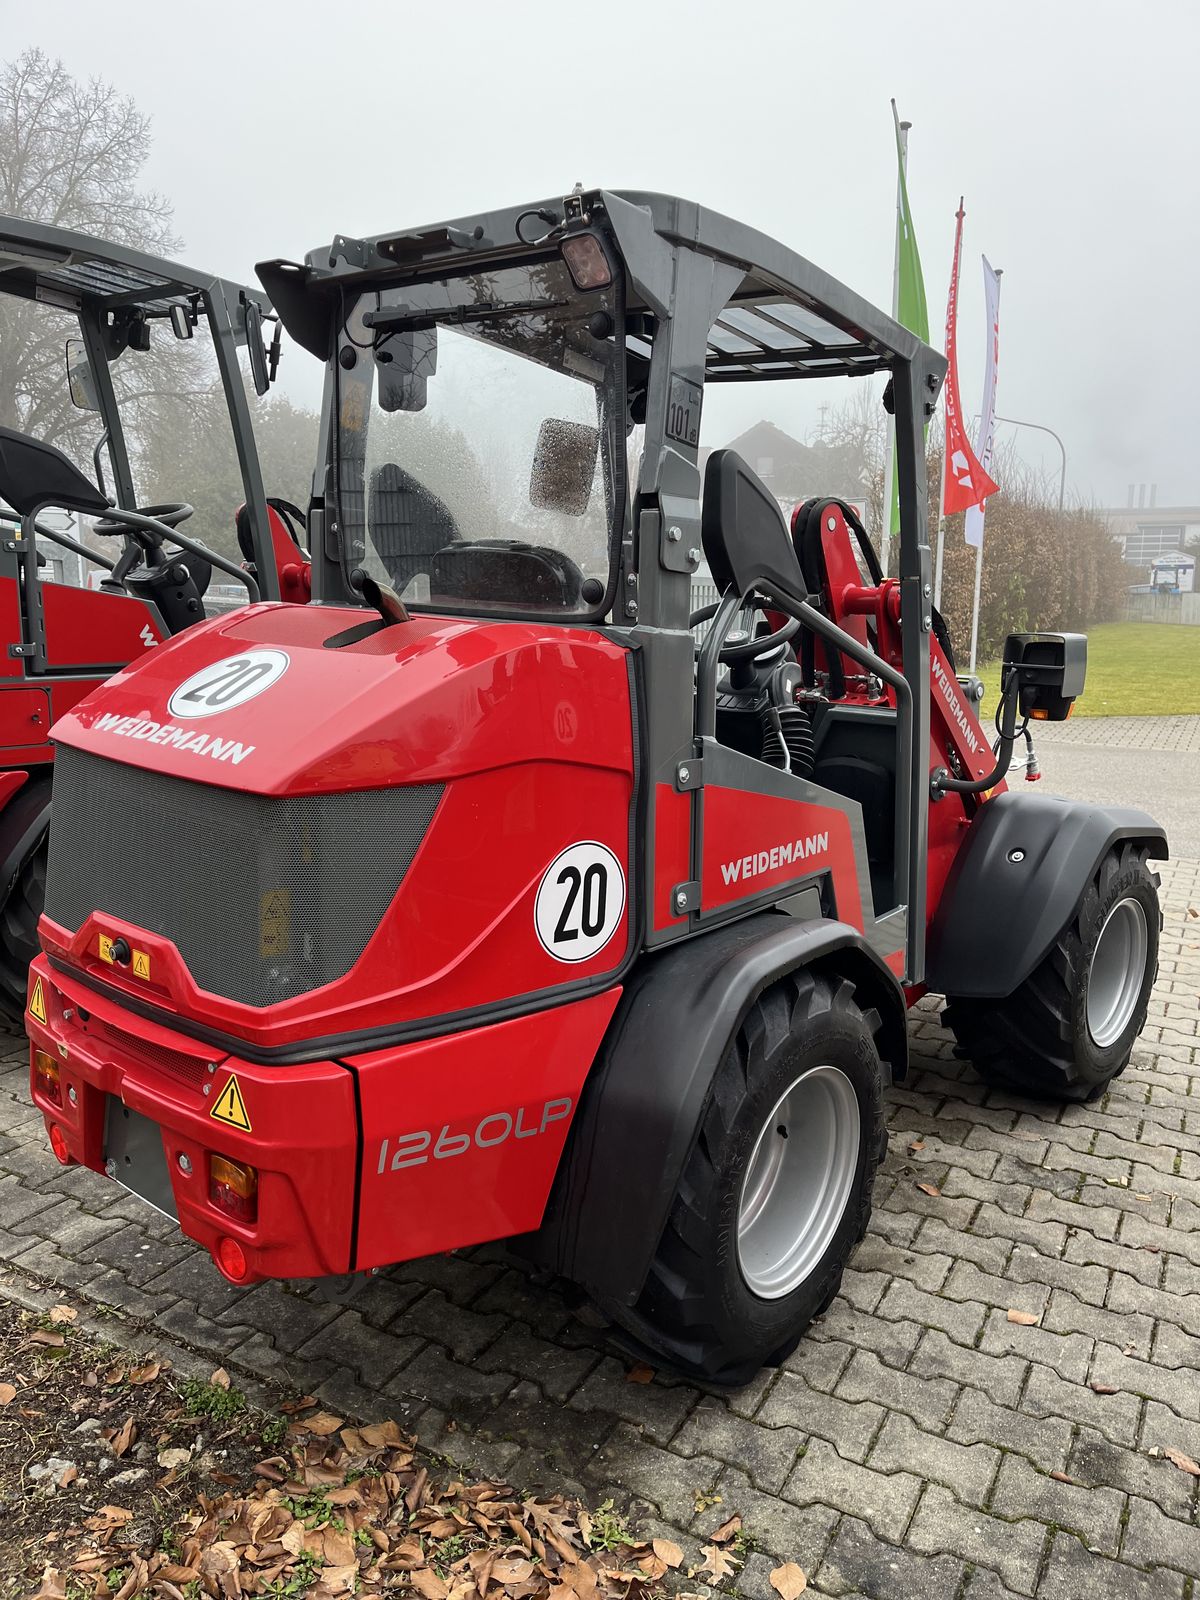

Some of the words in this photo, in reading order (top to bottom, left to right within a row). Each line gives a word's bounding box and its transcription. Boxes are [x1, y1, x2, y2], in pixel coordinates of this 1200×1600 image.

[670, 402, 690, 439] 101
[180, 659, 273, 706] 20
[931, 655, 979, 754] WEIDEMANN
[94, 712, 257, 766] WEIDEMANN
[720, 831, 829, 886] WEIDEMANN
[553, 862, 608, 944] 20
[377, 1097, 572, 1175] 1260LP
